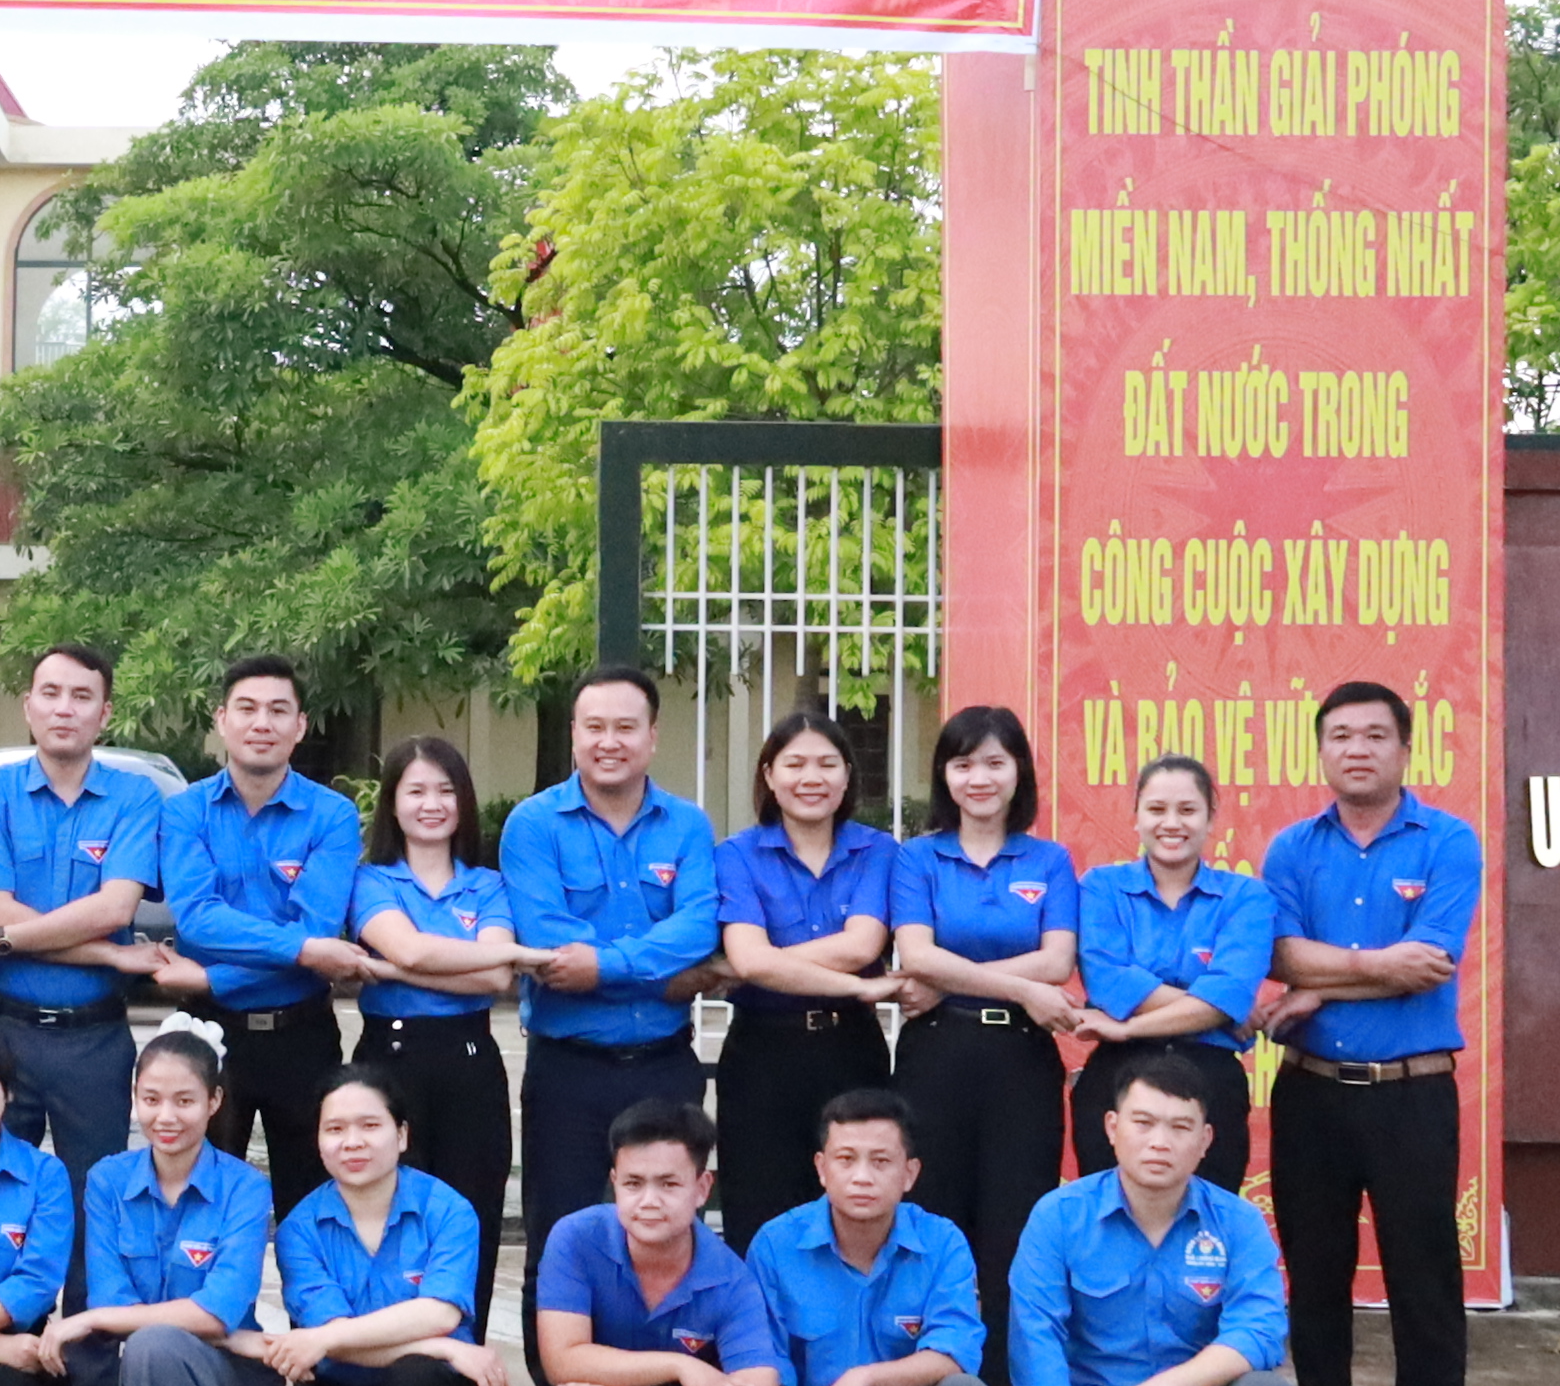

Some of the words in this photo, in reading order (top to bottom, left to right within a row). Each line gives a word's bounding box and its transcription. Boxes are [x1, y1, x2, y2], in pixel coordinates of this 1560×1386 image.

[1085, 49, 1161, 133] TINH
[1171, 18, 1259, 134] THẦN
[1271, 12, 1336, 135] GIẢI
[1347, 31, 1460, 136] PHÓNG
[1071, 177, 1158, 294] MIỀN
[1169, 211, 1256, 308] NAM,
[1268, 178, 1376, 296] THỐNG
[1387, 178, 1475, 296] NHẤT
[1123, 338, 1188, 455] ĐẤT
[1198, 343, 1290, 457] NƯỚC
[1300, 372, 1409, 457] TRONG
[1081, 521, 1173, 625] CÔNG
[1184, 522, 1273, 643] CUỘC
[1284, 522, 1348, 624] XÂY
[1359, 532, 1450, 643] DỰNG
[1084, 682, 1128, 784] VÀ
[1214, 682, 1255, 805] VỆ
[1266, 678, 1330, 785] VỮ
[1402, 669, 1455, 785] ẮC
